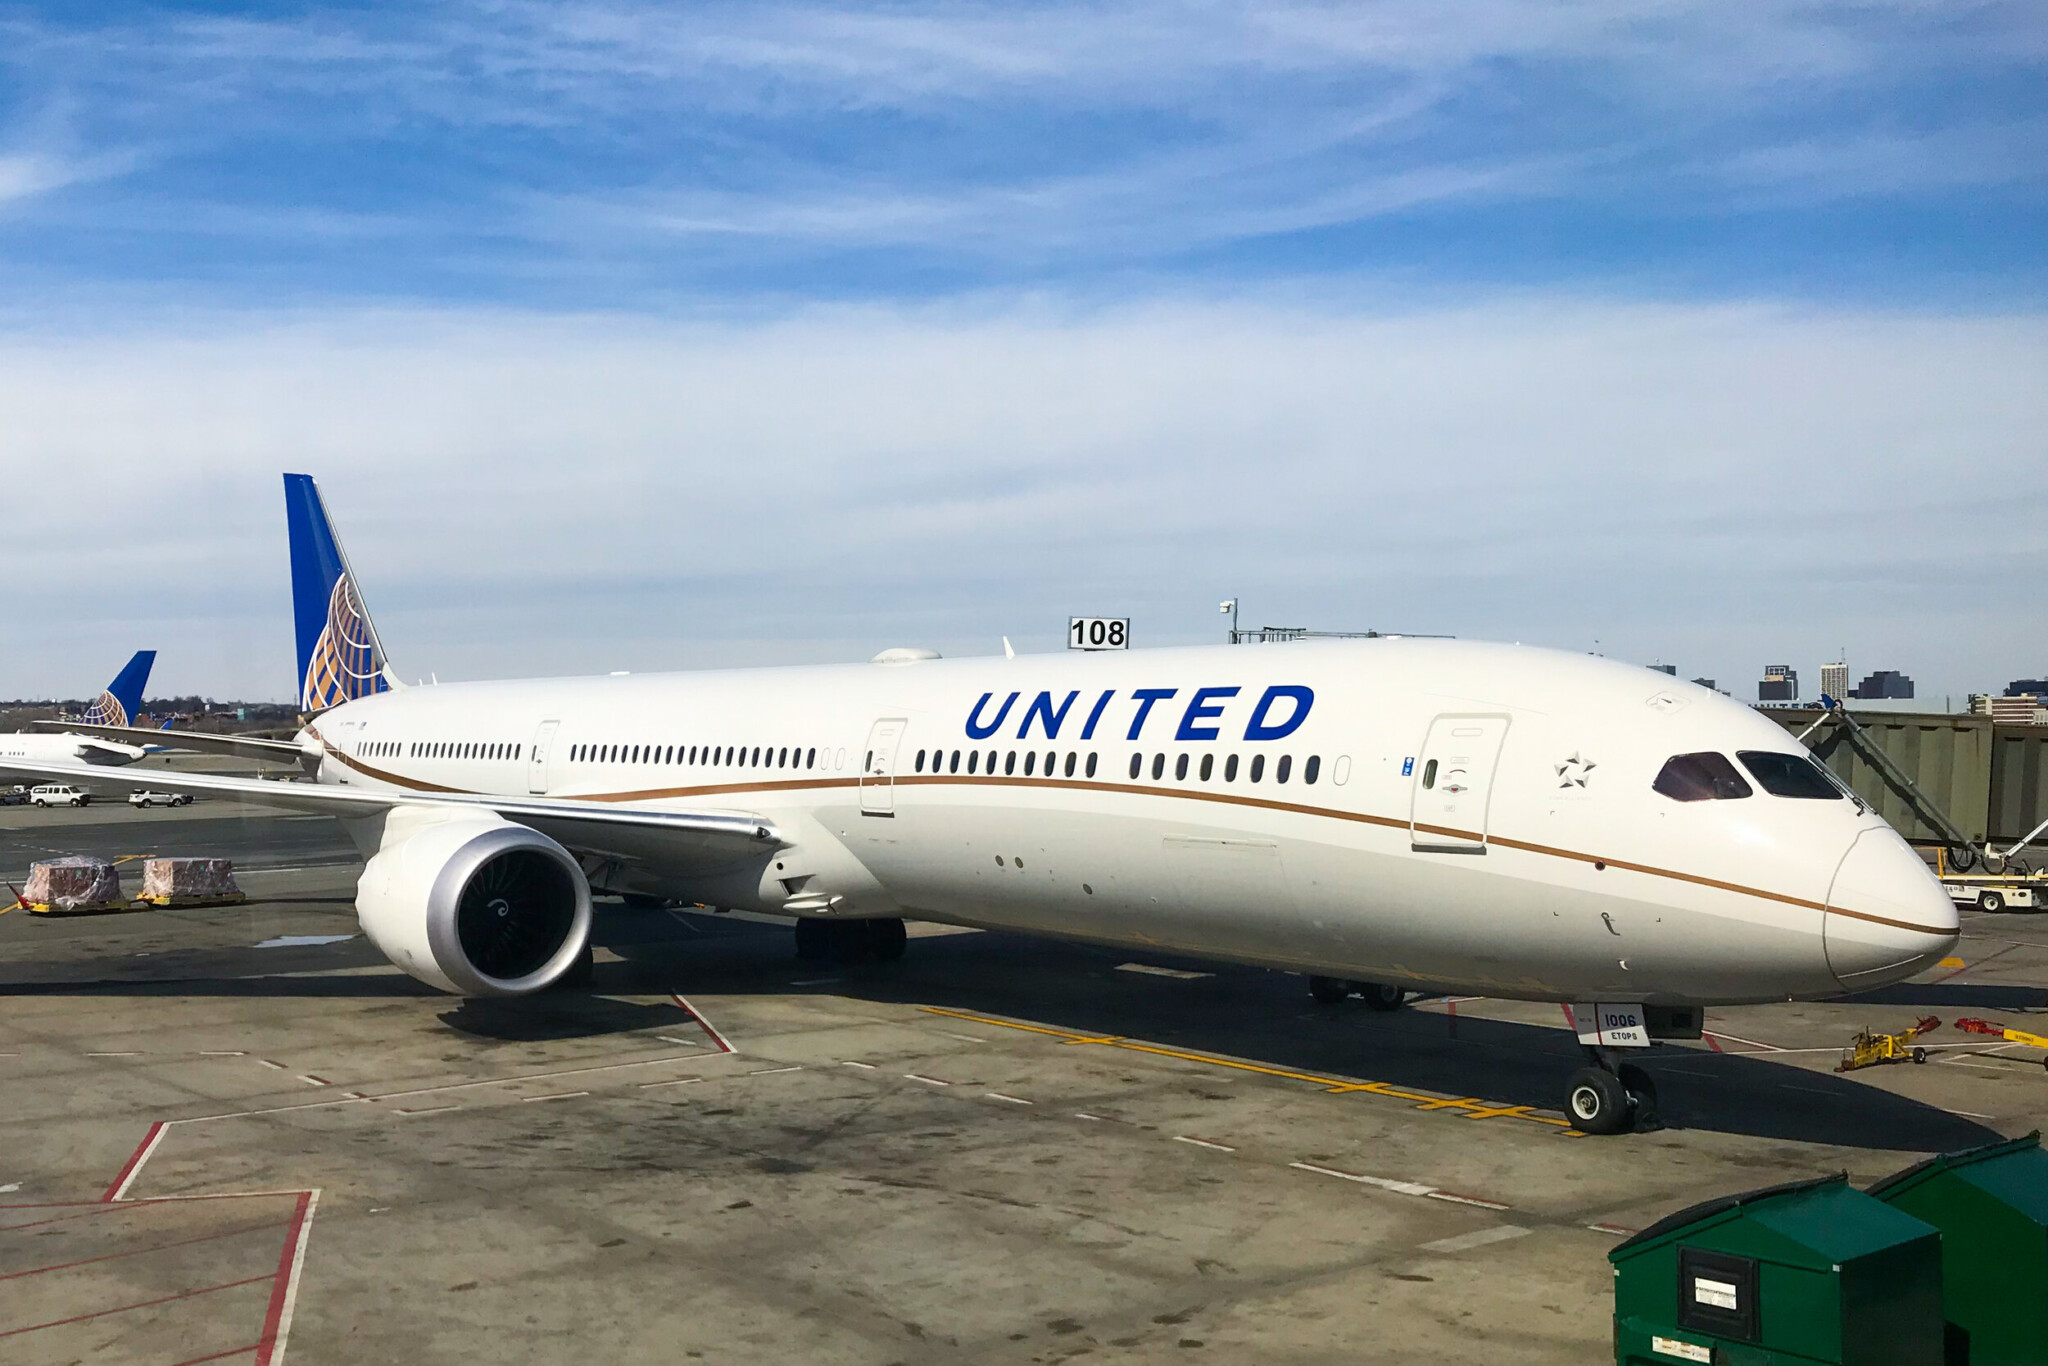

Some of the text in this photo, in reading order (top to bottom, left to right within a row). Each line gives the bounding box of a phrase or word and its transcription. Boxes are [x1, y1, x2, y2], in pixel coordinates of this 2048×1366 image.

[1072, 620, 1124, 645] 108
[965, 685, 1314, 741] UNITED
[1605, 1014, 1636, 1027] 1006
[1611, 1032, 1637, 1040] ETOPS
